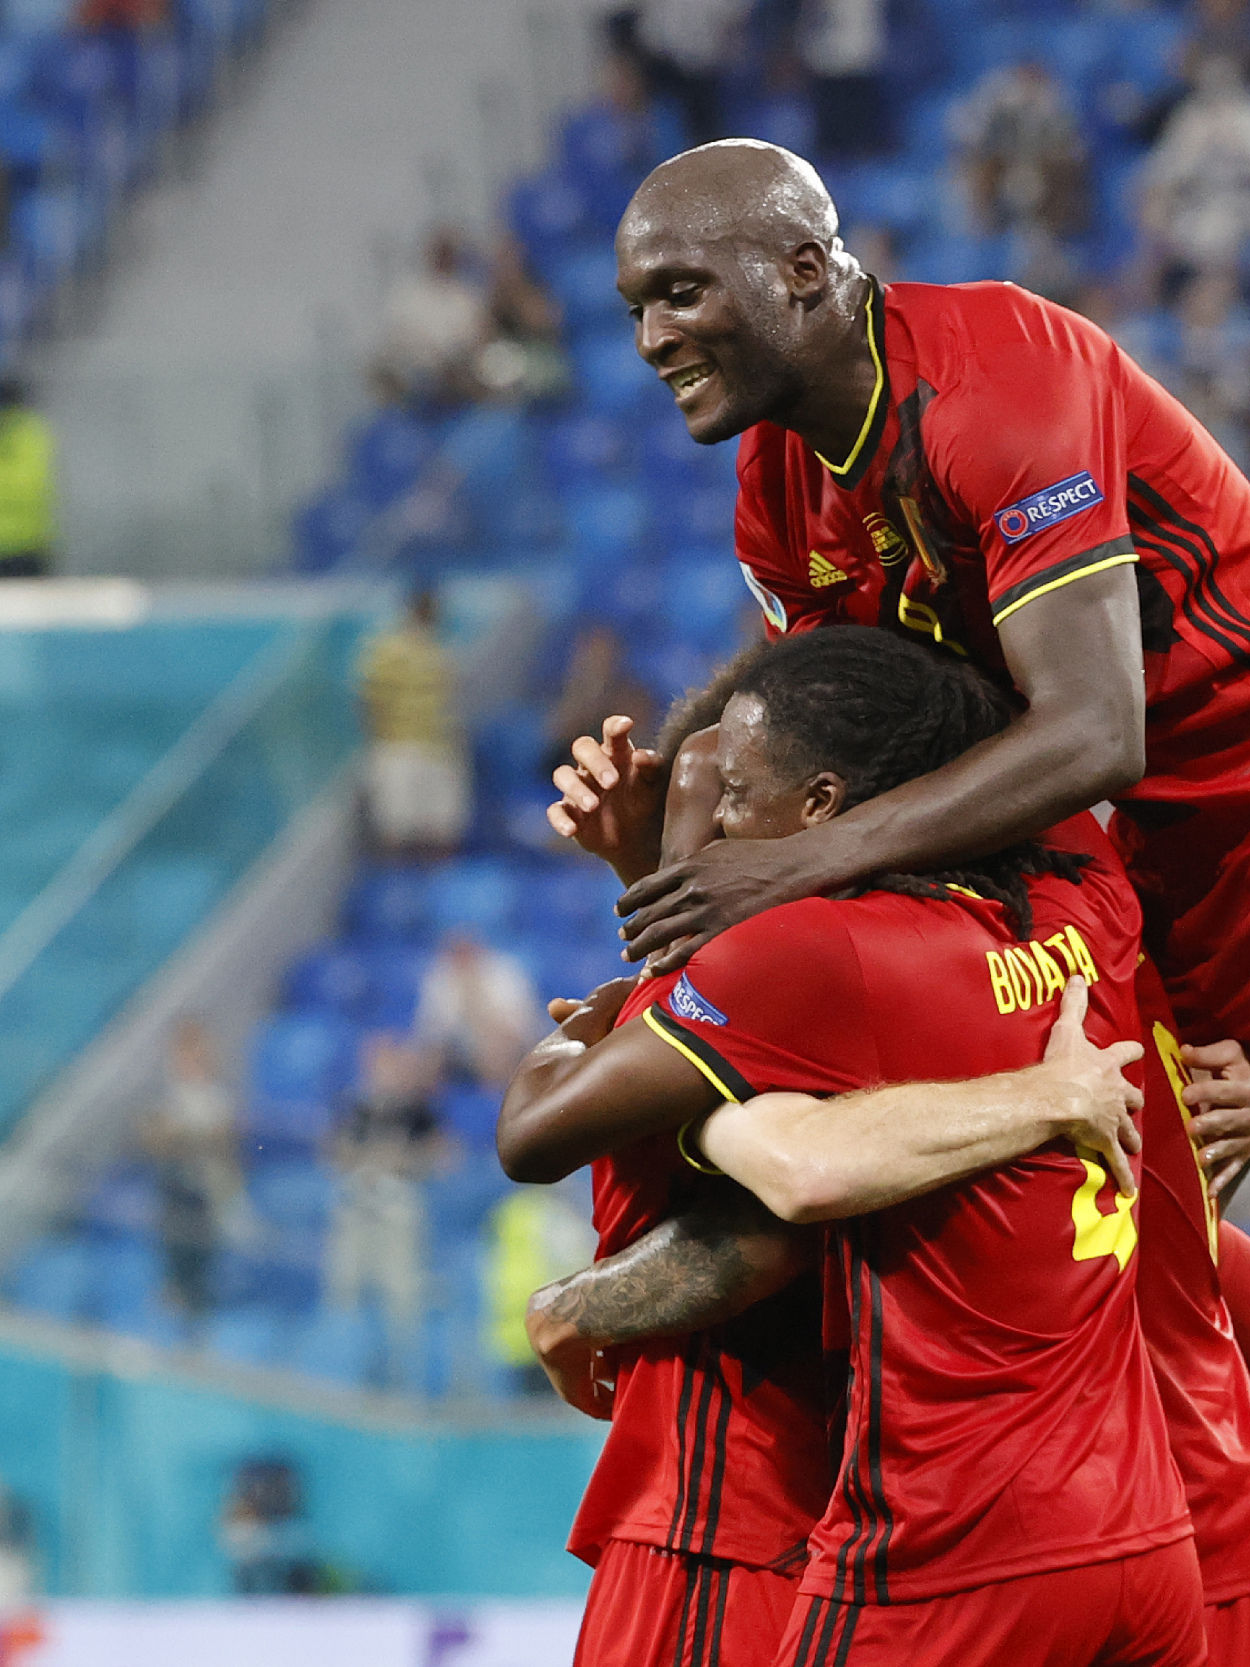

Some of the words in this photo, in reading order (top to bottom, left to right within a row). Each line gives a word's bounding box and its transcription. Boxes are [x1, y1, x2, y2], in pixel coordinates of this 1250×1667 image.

[1027, 478, 1096, 522] RESPECT
[985, 925, 1099, 1014] BOYATA
[673, 980, 719, 1026] RESPE
